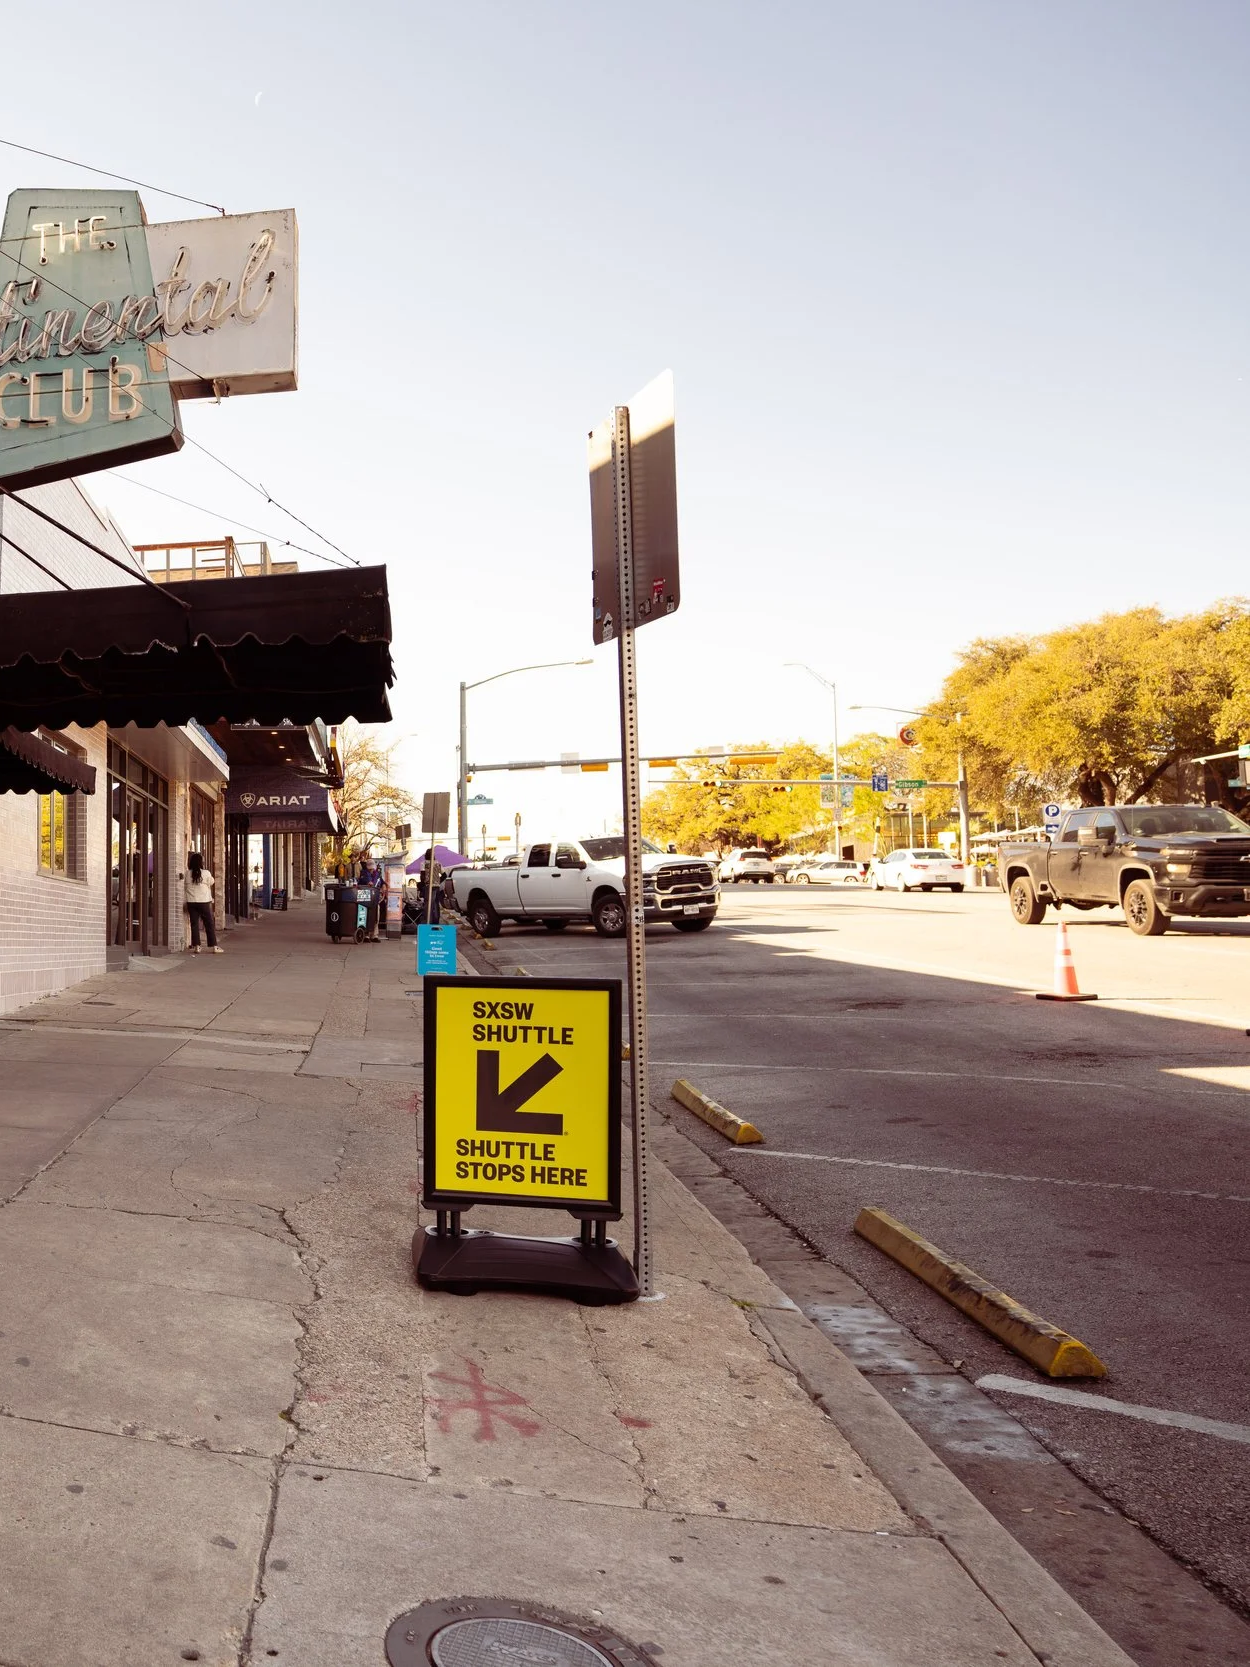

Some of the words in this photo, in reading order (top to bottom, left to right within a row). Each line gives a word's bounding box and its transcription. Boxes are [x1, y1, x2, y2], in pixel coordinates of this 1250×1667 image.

[32, 215, 117, 265] THE
[256, 796, 310, 806] ARIAT
[472, 1001, 535, 1020] SXSW
[472, 1024, 574, 1046] SHUTTLE
[455, 1138, 556, 1162] SHUTTLE
[455, 1161, 526, 1184] STOPS
[530, 1165, 588, 1187] HERE
